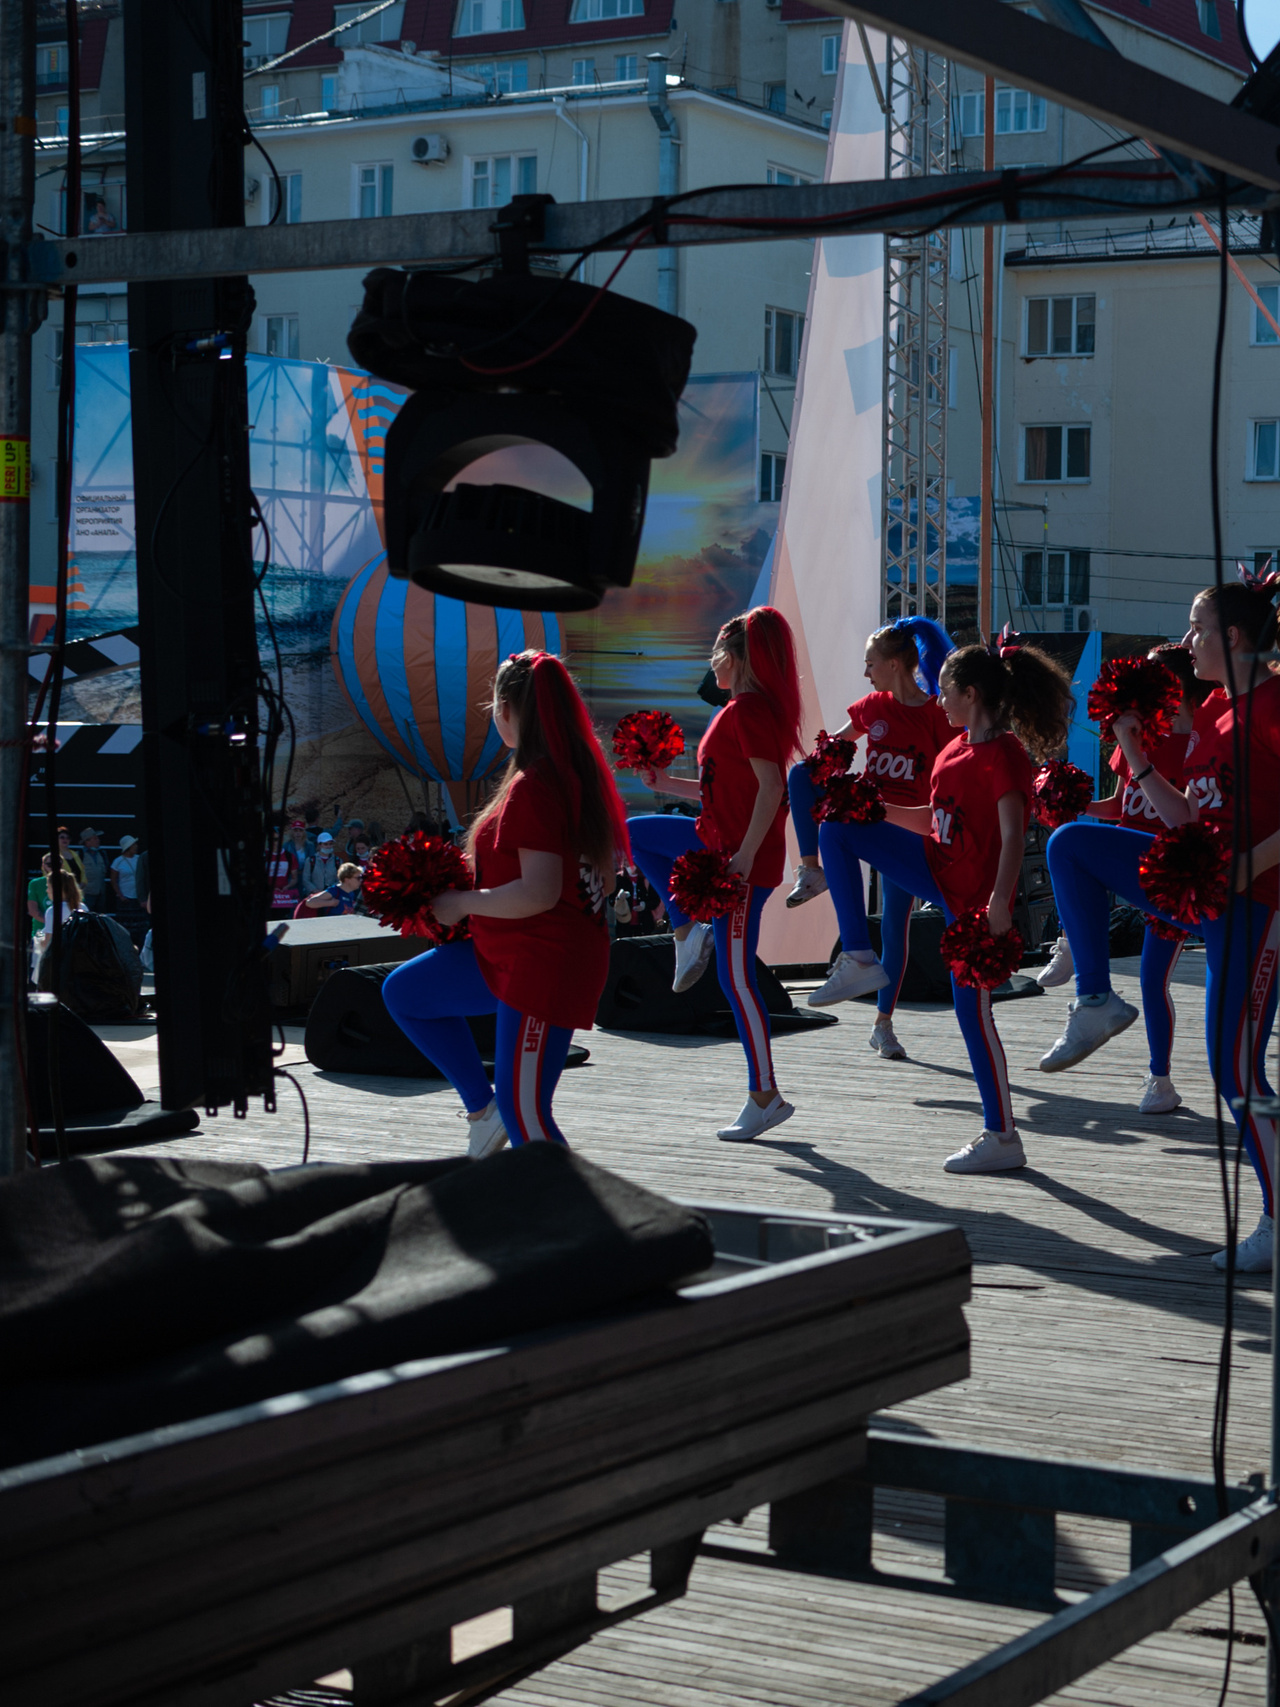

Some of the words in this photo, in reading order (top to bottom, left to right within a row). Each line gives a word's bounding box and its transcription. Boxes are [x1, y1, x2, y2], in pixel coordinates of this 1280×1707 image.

[6, 443, 15, 462] UP
[5, 466, 15, 490] PERI
[76, 494, 127, 502] ОФИЦИАЛЬНЫЙ
[867, 750, 915, 780] COOL
